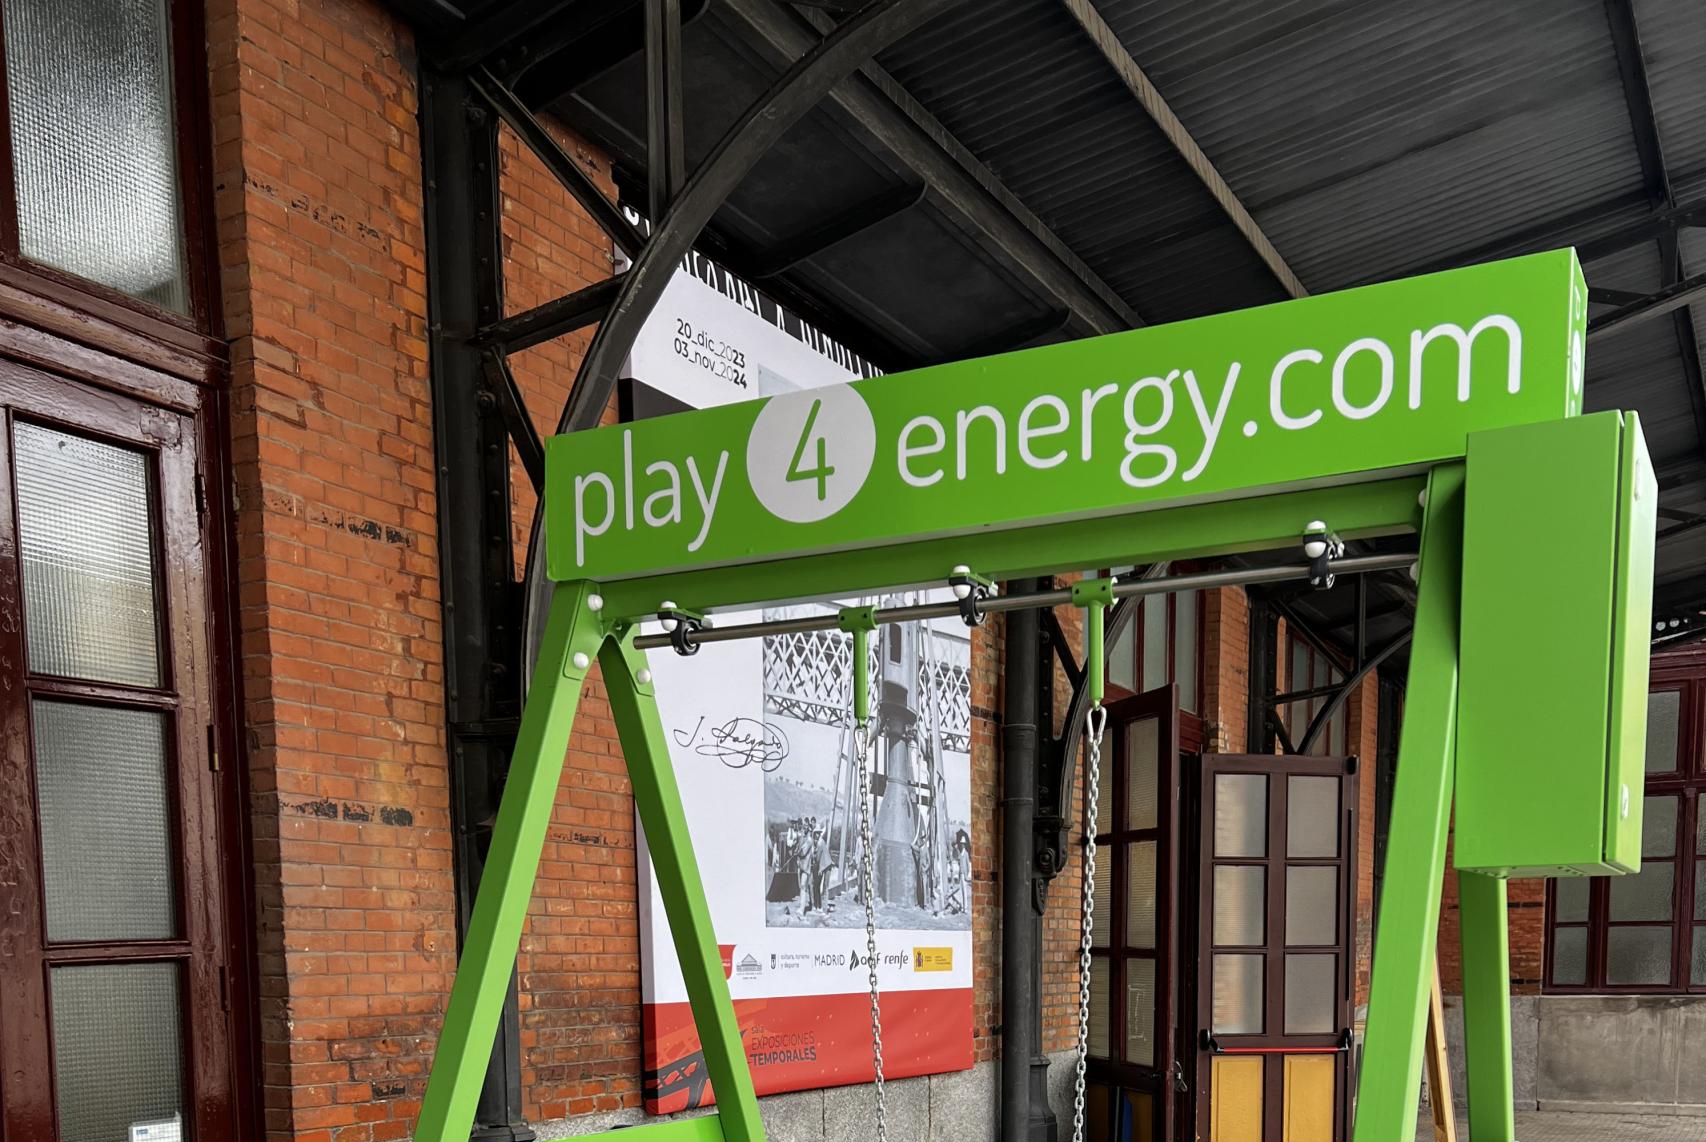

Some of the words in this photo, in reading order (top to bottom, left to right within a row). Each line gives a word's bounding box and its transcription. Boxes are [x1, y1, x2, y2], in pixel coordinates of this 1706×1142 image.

[574, 429, 729, 568] play
[785, 399, 836, 501] 4
[896, 313, 1523, 489] energy.com
[814, 954, 846, 967] MADRID
[884, 950, 909, 970] renfe
[752, 1031, 816, 1051] EXPOSICIONES
[750, 1046, 817, 1066] TEMPORALES
